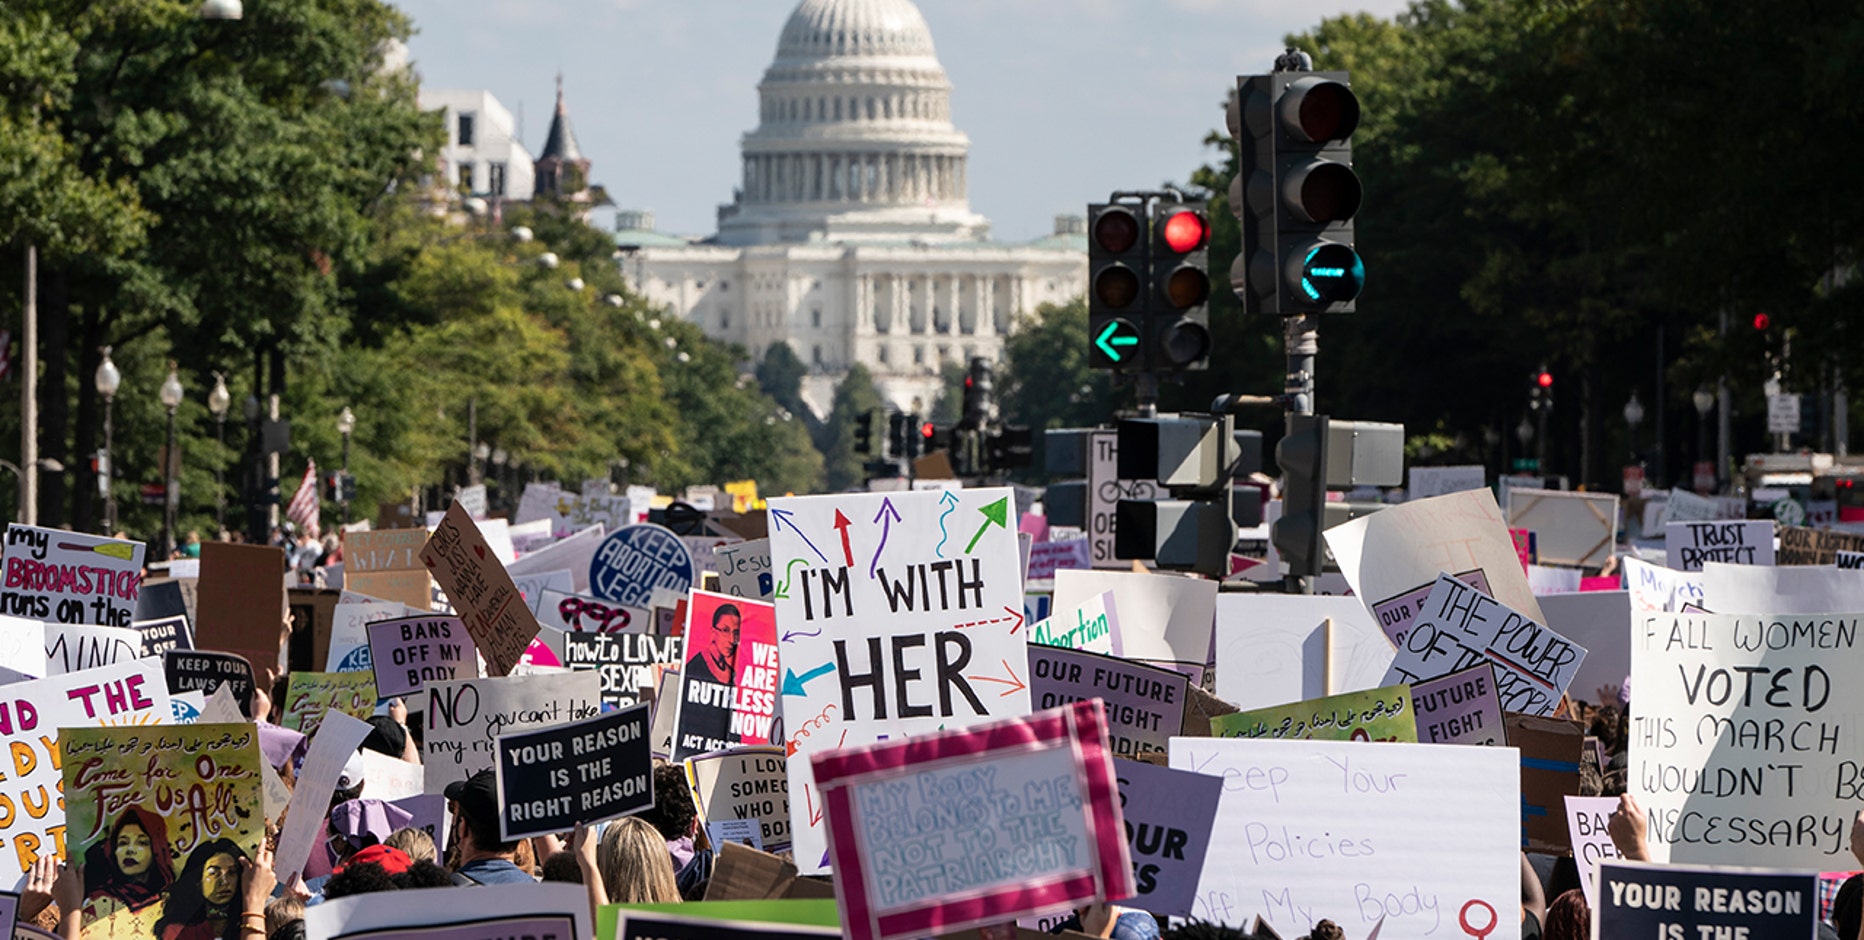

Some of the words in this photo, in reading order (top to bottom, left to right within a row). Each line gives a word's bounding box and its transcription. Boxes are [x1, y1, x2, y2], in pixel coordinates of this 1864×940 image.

[8, 527, 48, 560] my
[628, 528, 686, 568] KEEP
[1686, 523, 1746, 547] TRUST
[353, 547, 414, 571] WHAT
[599, 538, 690, 595] ABORTION
[720, 549, 772, 577] Jesu
[5, 556, 142, 601] BROOMSTICK
[801, 566, 854, 621] I'M
[877, 558, 984, 613] WITH
[0, 591, 50, 619] runs
[57, 598, 84, 625] on
[91, 596, 132, 628] the
[1381, 605, 1411, 626] OUR
[401, 621, 451, 642] BANS
[1407, 622, 1460, 662] OF
[1438, 576, 1499, 637] THE
[1490, 612, 1577, 696] POWER
[1666, 618, 1713, 651] ALL
[1733, 618, 1857, 652] WOMEN
[176, 657, 211, 671] KEEP
[215, 660, 249, 675] YOUR
[392, 644, 430, 667] OFF
[440, 644, 462, 662] MY
[752, 641, 779, 667] WE
[178, 676, 217, 691] LAWS
[740, 665, 779, 691] ARE
[832, 630, 990, 722] HER
[1035, 658, 1082, 684] OUR
[1093, 668, 1176, 705] FUTURE
[1679, 664, 1831, 713] VOTED
[66, 674, 154, 719] THE
[428, 682, 479, 731] NO
[1413, 676, 1488, 717] FUTURE
[682, 734, 705, 750] ACT
[730, 711, 773, 739] NOW
[1428, 709, 1484, 743] FIGHT
[1635, 716, 1677, 749] THIS
[1697, 714, 1840, 755] MARCH
[428, 738, 467, 764] my
[509, 739, 564, 767] YOUR
[572, 720, 642, 756] REASON
[66, 754, 134, 790] Come
[137, 754, 182, 788] for
[550, 767, 569, 789] IS
[577, 756, 612, 782] THE
[741, 760, 747, 774] I
[509, 795, 572, 823] RIGHT
[581, 773, 648, 811] REASON
[858, 781, 911, 817] MY
[916, 764, 998, 802] BODY
[80, 781, 145, 845] Face
[155, 784, 186, 813] Us
[177, 780, 239, 850] All
[732, 800, 774, 820] WHO
[873, 833, 946, 875] NOT
[953, 826, 997, 856] TO
[1001, 809, 1068, 844] THE
[1244, 821, 1375, 865] Policies
[878, 834, 1079, 906] PATRIARCHY
[1262, 886, 1313, 926] My
[1354, 882, 1441, 935] Body
[1608, 880, 1681, 912] YOUR
[1694, 883, 1802, 915] REASON
[1658, 922, 1683, 940] IS
